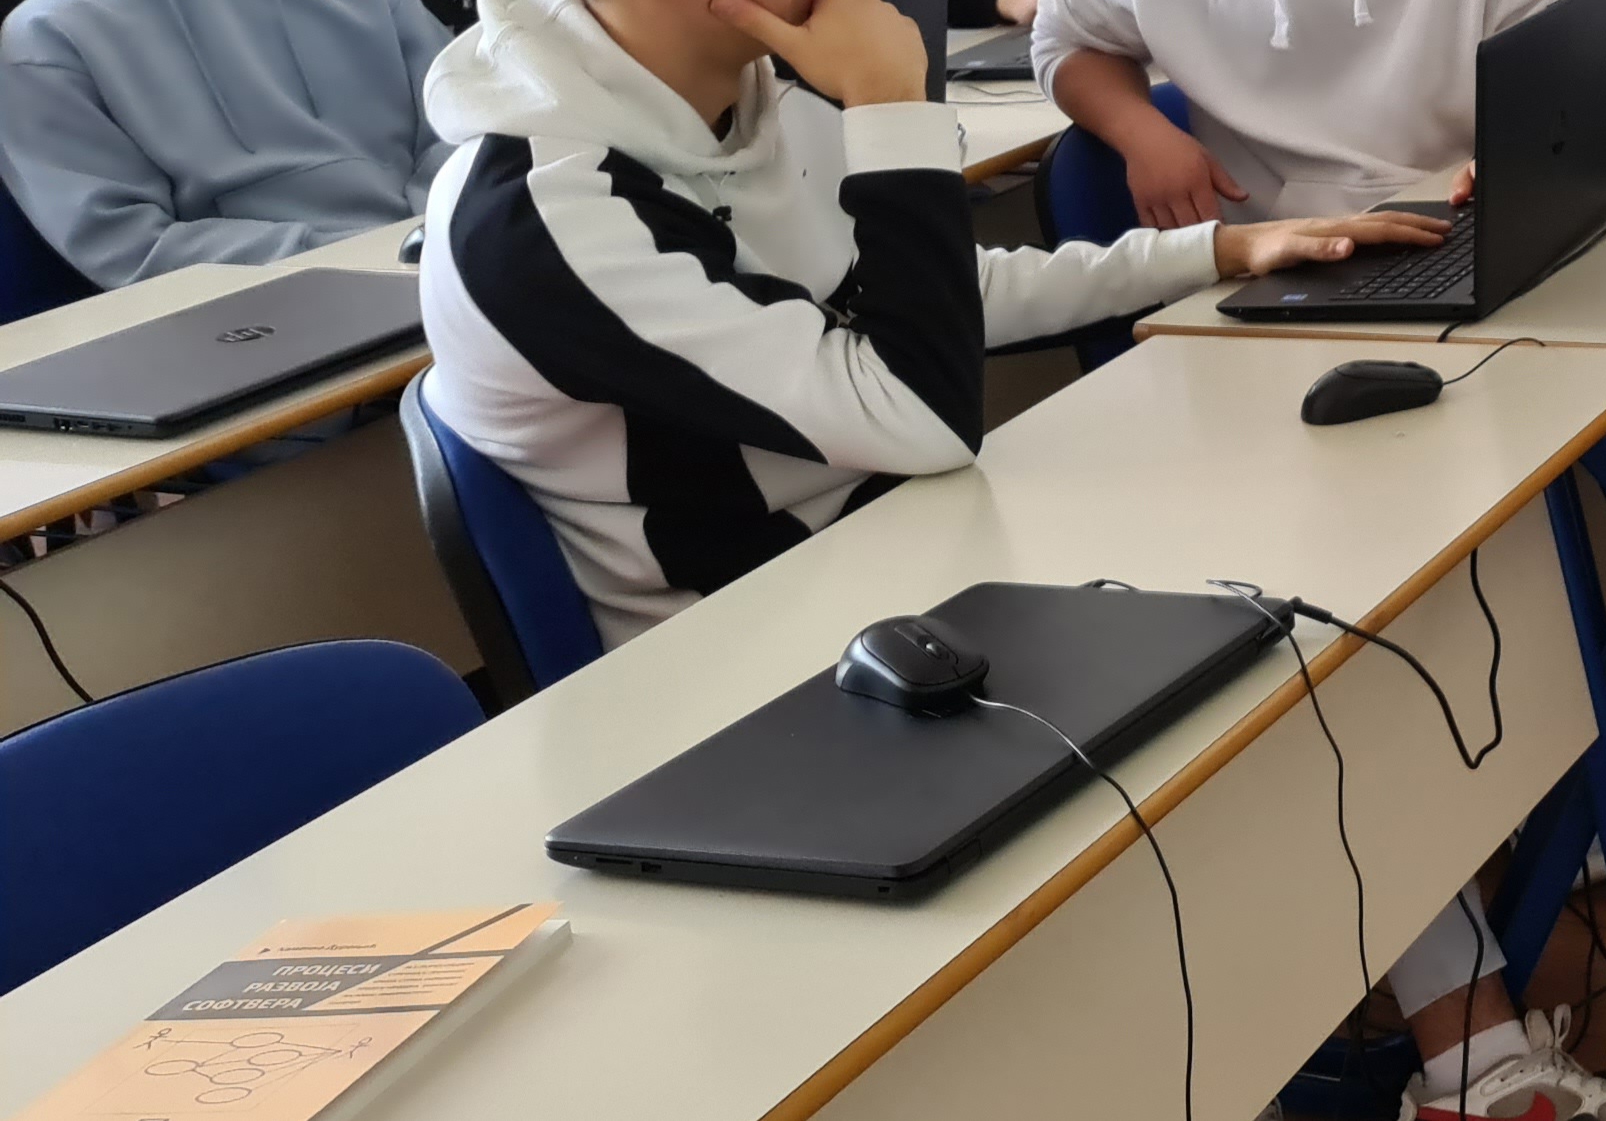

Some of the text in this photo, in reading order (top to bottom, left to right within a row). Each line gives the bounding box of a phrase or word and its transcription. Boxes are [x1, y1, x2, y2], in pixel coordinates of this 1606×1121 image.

[272, 963, 382, 977] ПРОЦЕСИ
[242, 980, 342, 993] РАЗВОЈА
[182, 997, 304, 1011] СОФТВЕРА
